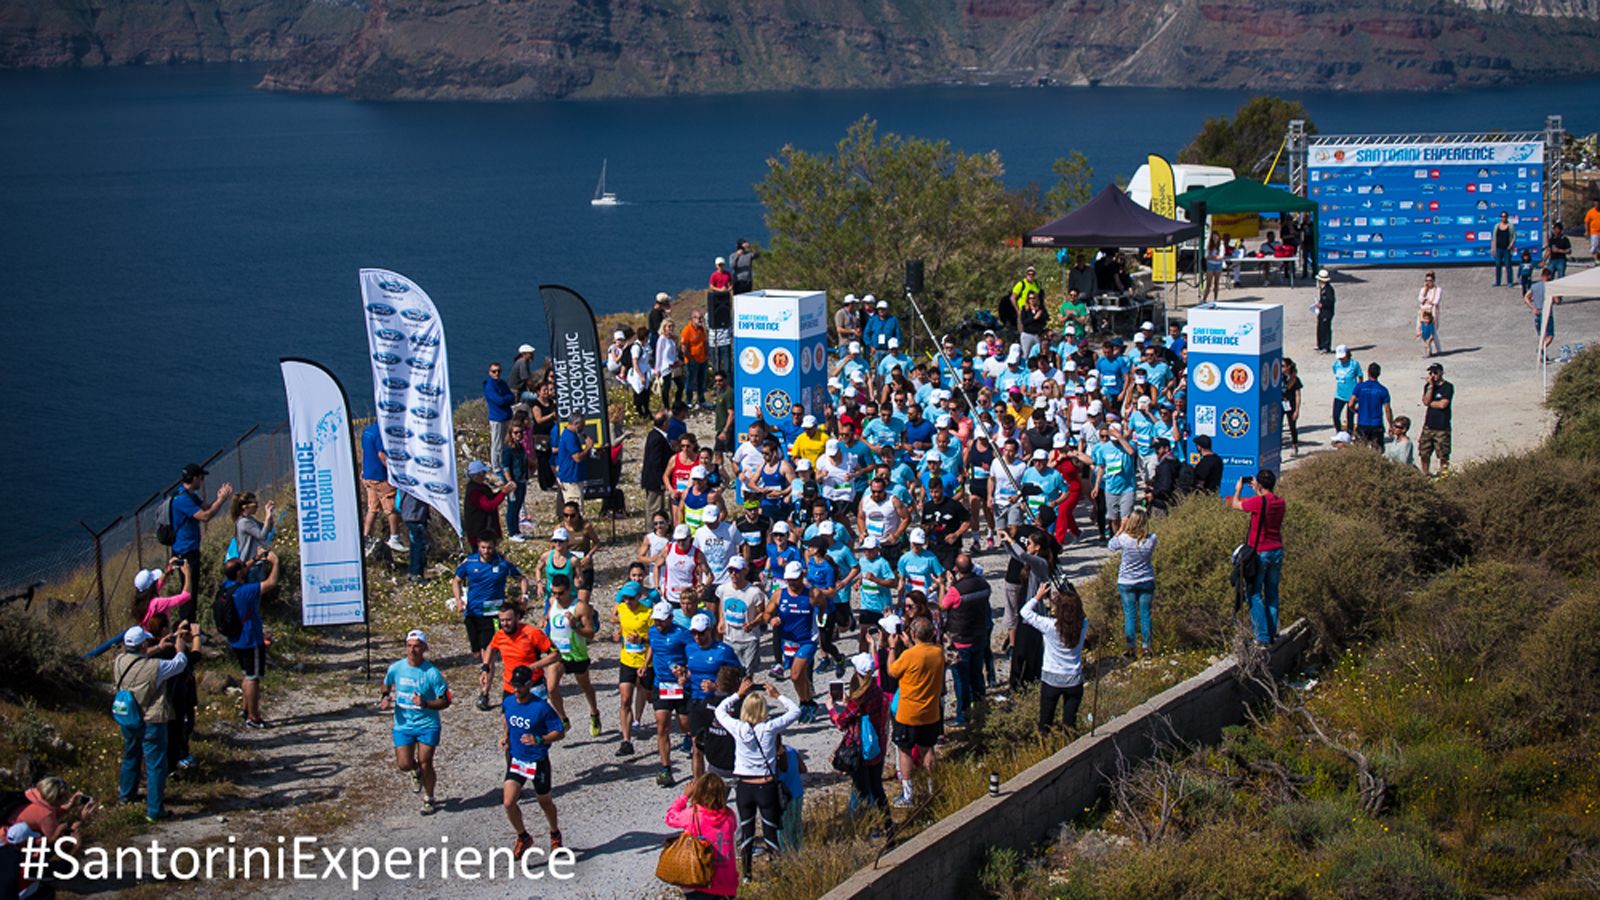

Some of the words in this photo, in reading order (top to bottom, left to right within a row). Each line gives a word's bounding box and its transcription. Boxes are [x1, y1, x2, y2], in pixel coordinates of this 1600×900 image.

[1356, 147, 1421, 163] SANTORINI
[1423, 146, 1495, 162] EXPERIENCE
[1192, 335, 1239, 346] EXPERIENCE
